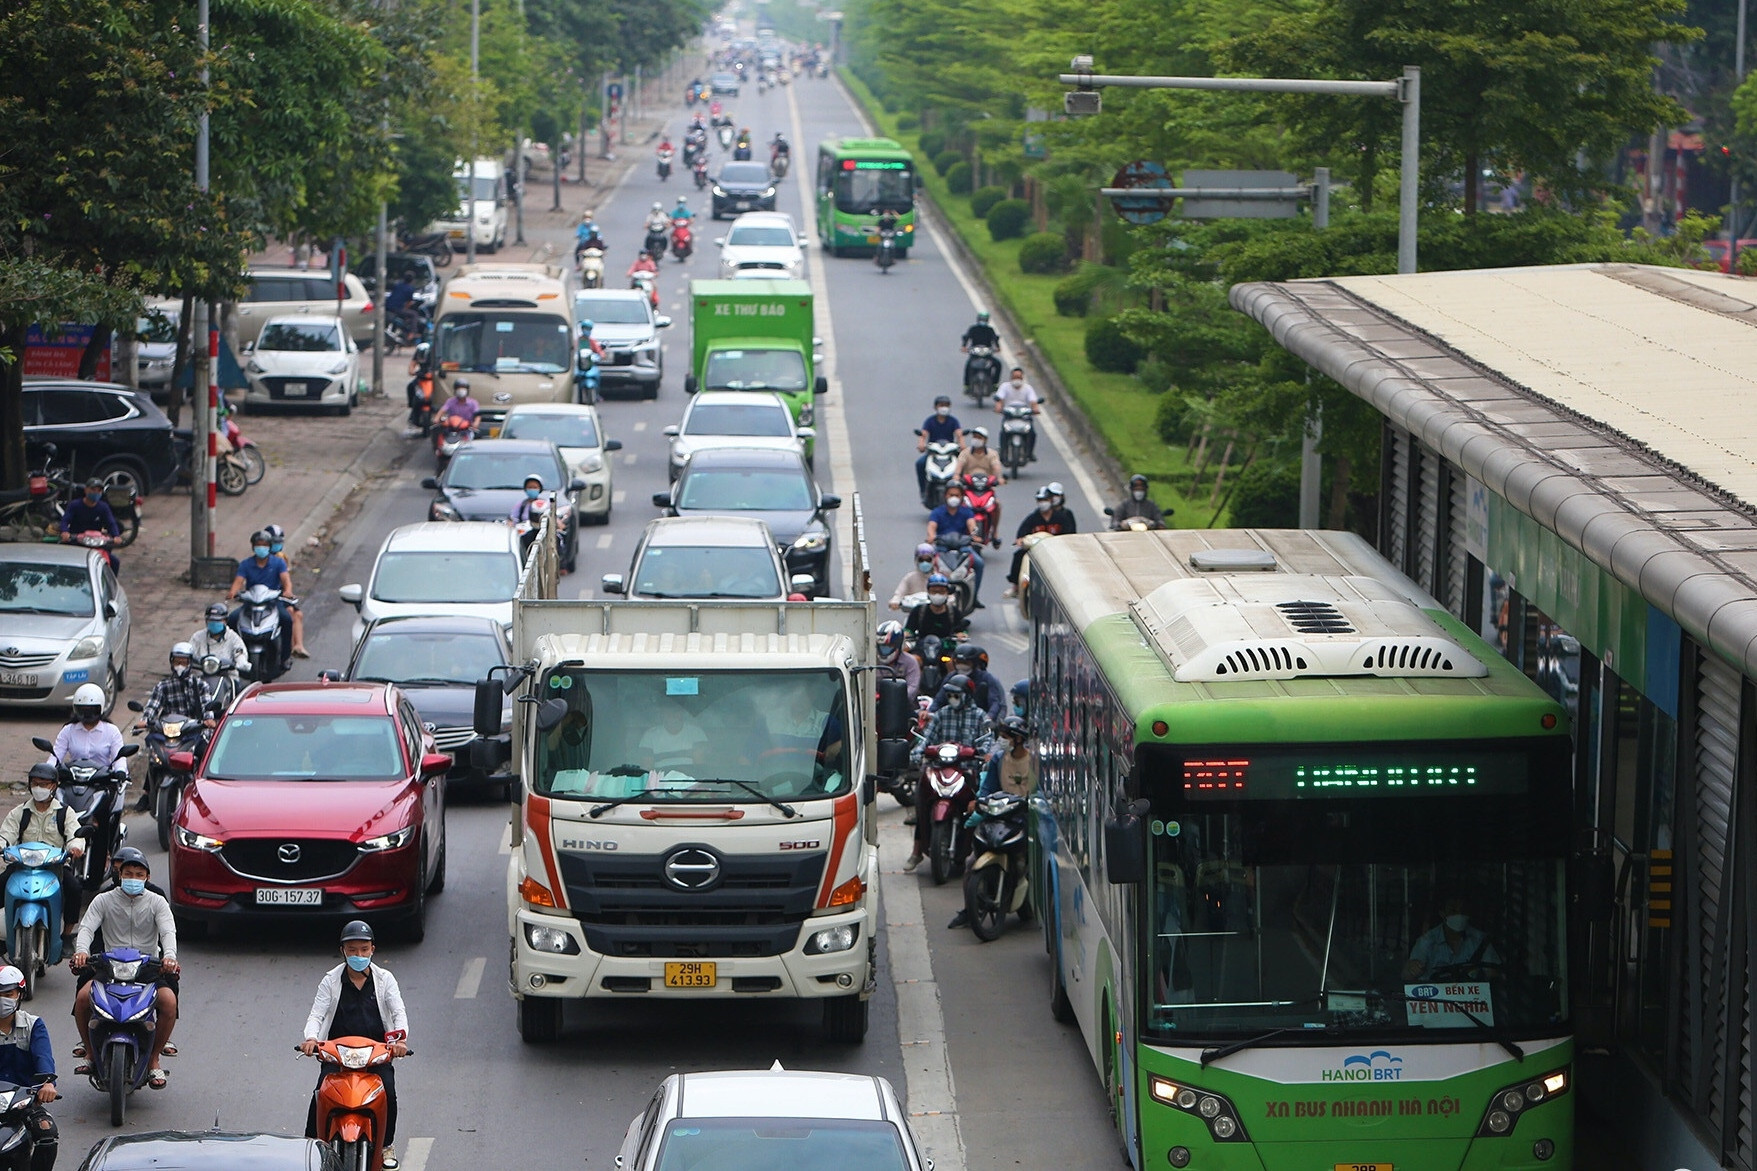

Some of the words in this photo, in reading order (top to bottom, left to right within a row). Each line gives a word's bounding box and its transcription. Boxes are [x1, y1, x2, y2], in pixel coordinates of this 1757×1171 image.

[714, 303, 731, 316] XE
[733, 302, 759, 316] THƯ
[760, 301, 786, 317] BÁO
[562, 839, 619, 851] HINO
[779, 838, 821, 851] 500
[257, 889, 321, 904] 30G-157.37
[679, 963, 702, 974] 29H
[670, 974, 711, 986] 413.93
[1416, 986, 1434, 997] BRT
[1467, 985, 1481, 996] XE
[1321, 1068, 1372, 1081] HANOI
[1373, 1067, 1403, 1081] BRT
[1294, 1100, 1327, 1118] BUS
[1331, 1099, 1393, 1118] NHANH
[1398, 1095, 1423, 1117] HÀ
[1426, 1094, 1461, 1119] NỘI
